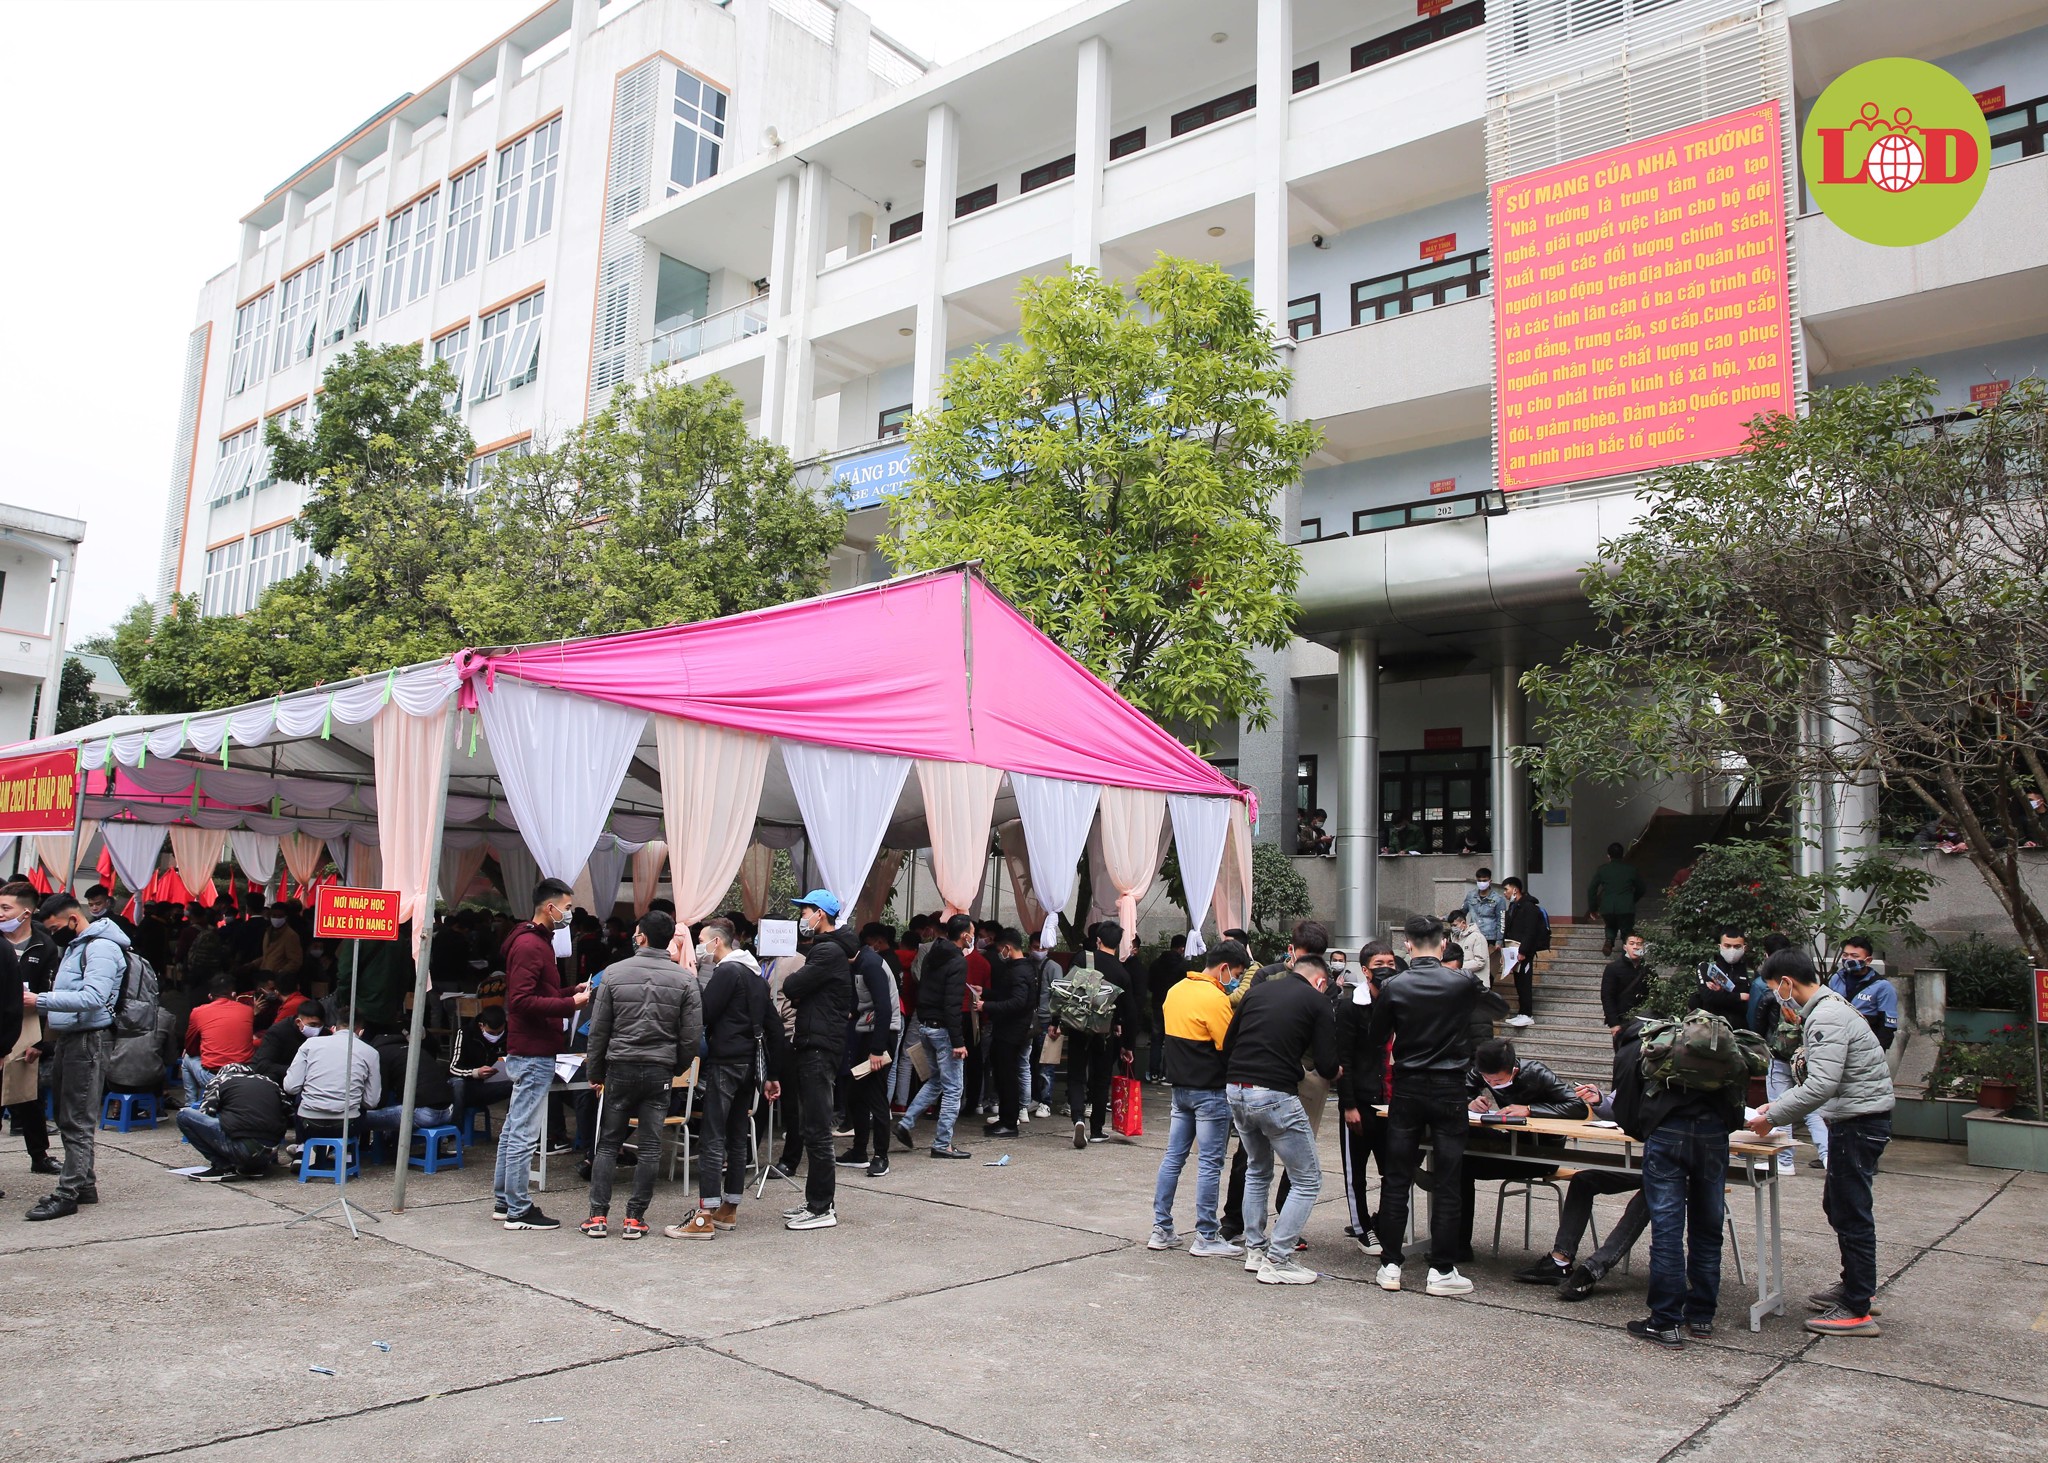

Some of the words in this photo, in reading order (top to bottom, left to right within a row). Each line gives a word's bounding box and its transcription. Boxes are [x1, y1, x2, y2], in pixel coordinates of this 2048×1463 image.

[1506, 190, 1532, 213] SỨ
[1535, 175, 1590, 204] MẠNG
[1595, 161, 1632, 189] CỦA
[1637, 147, 1678, 176] NHÀ
[1684, 124, 1765, 162] TRƯỜNG
[1545, 204, 1590, 228] trường
[1598, 197, 1612, 214] là
[1620, 187, 1659, 208] trung
[1668, 176, 1697, 195] tâm
[1706, 165, 1735, 185] đào
[1744, 155, 1769, 174] tạo
[1505, 267, 1534, 289] xuất
[1540, 261, 1566, 280] ngũ
[1571, 254, 1597, 272] các
[1603, 243, 1626, 265] đối
[1632, 236, 1674, 257] tượng
[1681, 222, 1724, 245] chính
[1731, 210, 1774, 233] sách,
[1545, 233, 1571, 255] giải
[1575, 220, 1614, 247] quyết
[1618, 215, 1649, 235] việc
[1654, 207, 1683, 224] làm
[1688, 198, 1716, 216] cho
[1721, 188, 1741, 208] bộ
[1746, 181, 1771, 201] đội
[1505, 293, 1543, 314] người
[1546, 288, 1568, 304] lao
[1569, 280, 1604, 300] động
[1608, 270, 1637, 290] trên
[1639, 266, 1663, 284] địa
[1664, 258, 1693, 277] bàn
[1694, 248, 1734, 270] Quân
[1505, 322, 1521, 340] và
[1524, 318, 1550, 335] các
[1553, 310, 1581, 328] tỉnh
[1584, 304, 1607, 322] lân
[1610, 298, 1637, 317] cận
[1641, 292, 1651, 309] ở
[1654, 291, 1673, 307] ba
[1677, 280, 1706, 301] cấp
[1710, 272, 1747, 294] trình
[1506, 348, 1532, 365] cao
[1534, 338, 1571, 359] đẳng,
[1574, 331, 1612, 351] trung
[1615, 320, 1646, 342] cấp,
[1650, 319, 1668, 335] sơ
[1747, 291, 1776, 314] cấp
[1552, 362, 1587, 381] nhân
[1591, 358, 1614, 375] lực
[1619, 344, 1652, 368] chất
[1656, 341, 1700, 360] lượng
[1704, 333, 1733, 351] cao
[1739, 324, 1779, 346] phục
[1507, 403, 1523, 418] vụ
[1527, 397, 1553, 413] cho
[1557, 387, 1588, 409] phát
[1592, 376, 1626, 400] triển
[1631, 374, 1664, 393] kinh
[1669, 366, 1684, 386] tế
[1689, 364, 1707, 382] xã
[1712, 358, 1741, 378] hội,
[1748, 353, 1777, 371] xóa
[1509, 425, 1534, 444] đói,
[1536, 418, 1571, 440] giảm
[1573, 411, 1620, 432] nghèo.
[1623, 403, 1656, 423] Đảm
[1659, 396, 1687, 416] bảo
[1689, 386, 1728, 411] Quốc
[1731, 382, 1781, 404] phòng
[1509, 455, 1527, 470] an
[1529, 448, 1560, 466] ninh
[1563, 442, 1595, 462] phía
[1598, 433, 1625, 454] bắc
[1629, 428, 1644, 449] tổ
[1437, 506, 1452, 516] 202
[56, 774, 73, 818] HỌC
[322, 913, 335, 928] LÁI
[336, 916, 346, 929] XE
[355, 915, 364, 930] TÔ
[365, 918, 386, 933] HẠNG
[387, 920, 393, 931] C
[333, 896, 347, 908] NƠI
[348, 895, 369, 912] NHẬP
[370, 898, 386, 913] HỌC
[1857, 992, 1872, 1002] K&K
